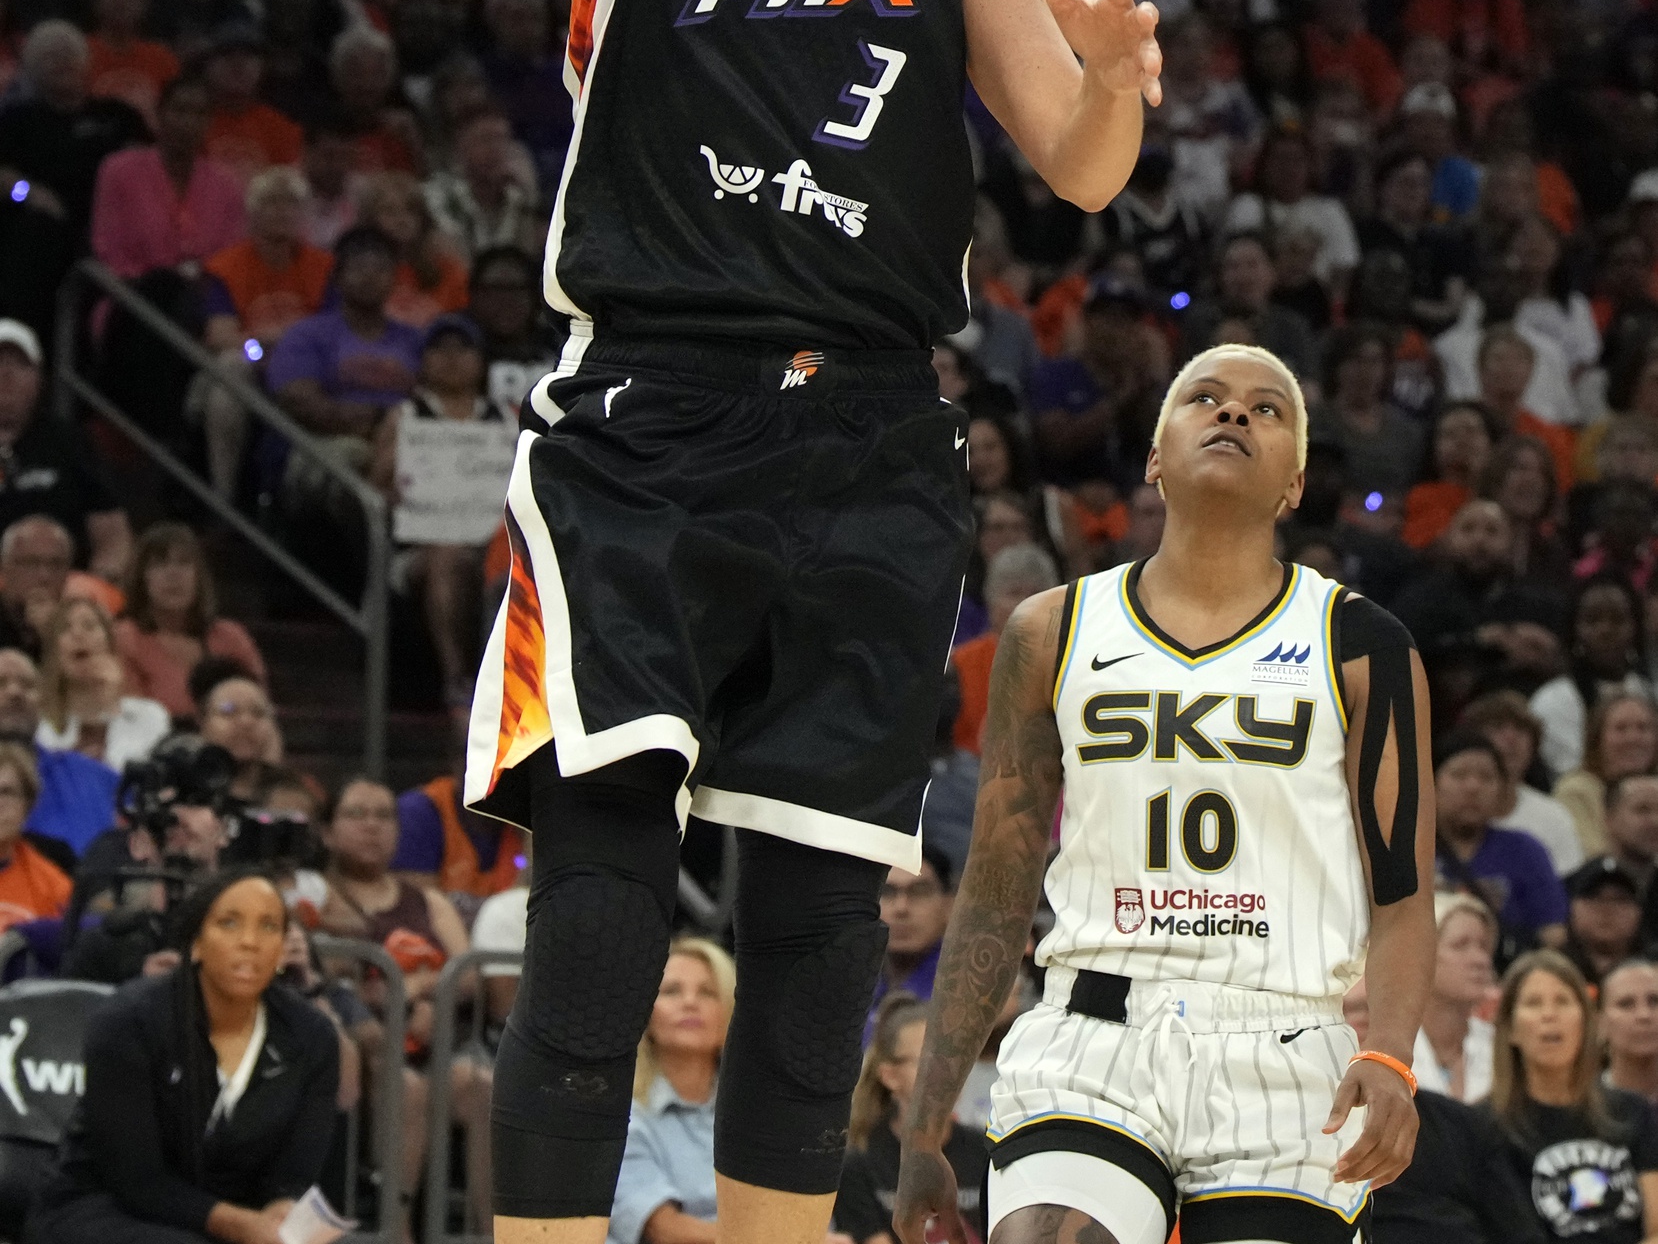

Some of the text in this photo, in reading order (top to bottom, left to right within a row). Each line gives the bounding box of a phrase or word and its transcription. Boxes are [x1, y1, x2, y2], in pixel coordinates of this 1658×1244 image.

[818, 41, 907, 144] 3
[823, 193, 864, 213] STORES
[1252, 665, 1310, 676] MAGELLAN
[1075, 689, 1317, 770] SKY
[1145, 786, 1239, 875] 10
[1150, 889, 1266, 914] UChicago
[1150, 915, 1269, 939] Medicine
